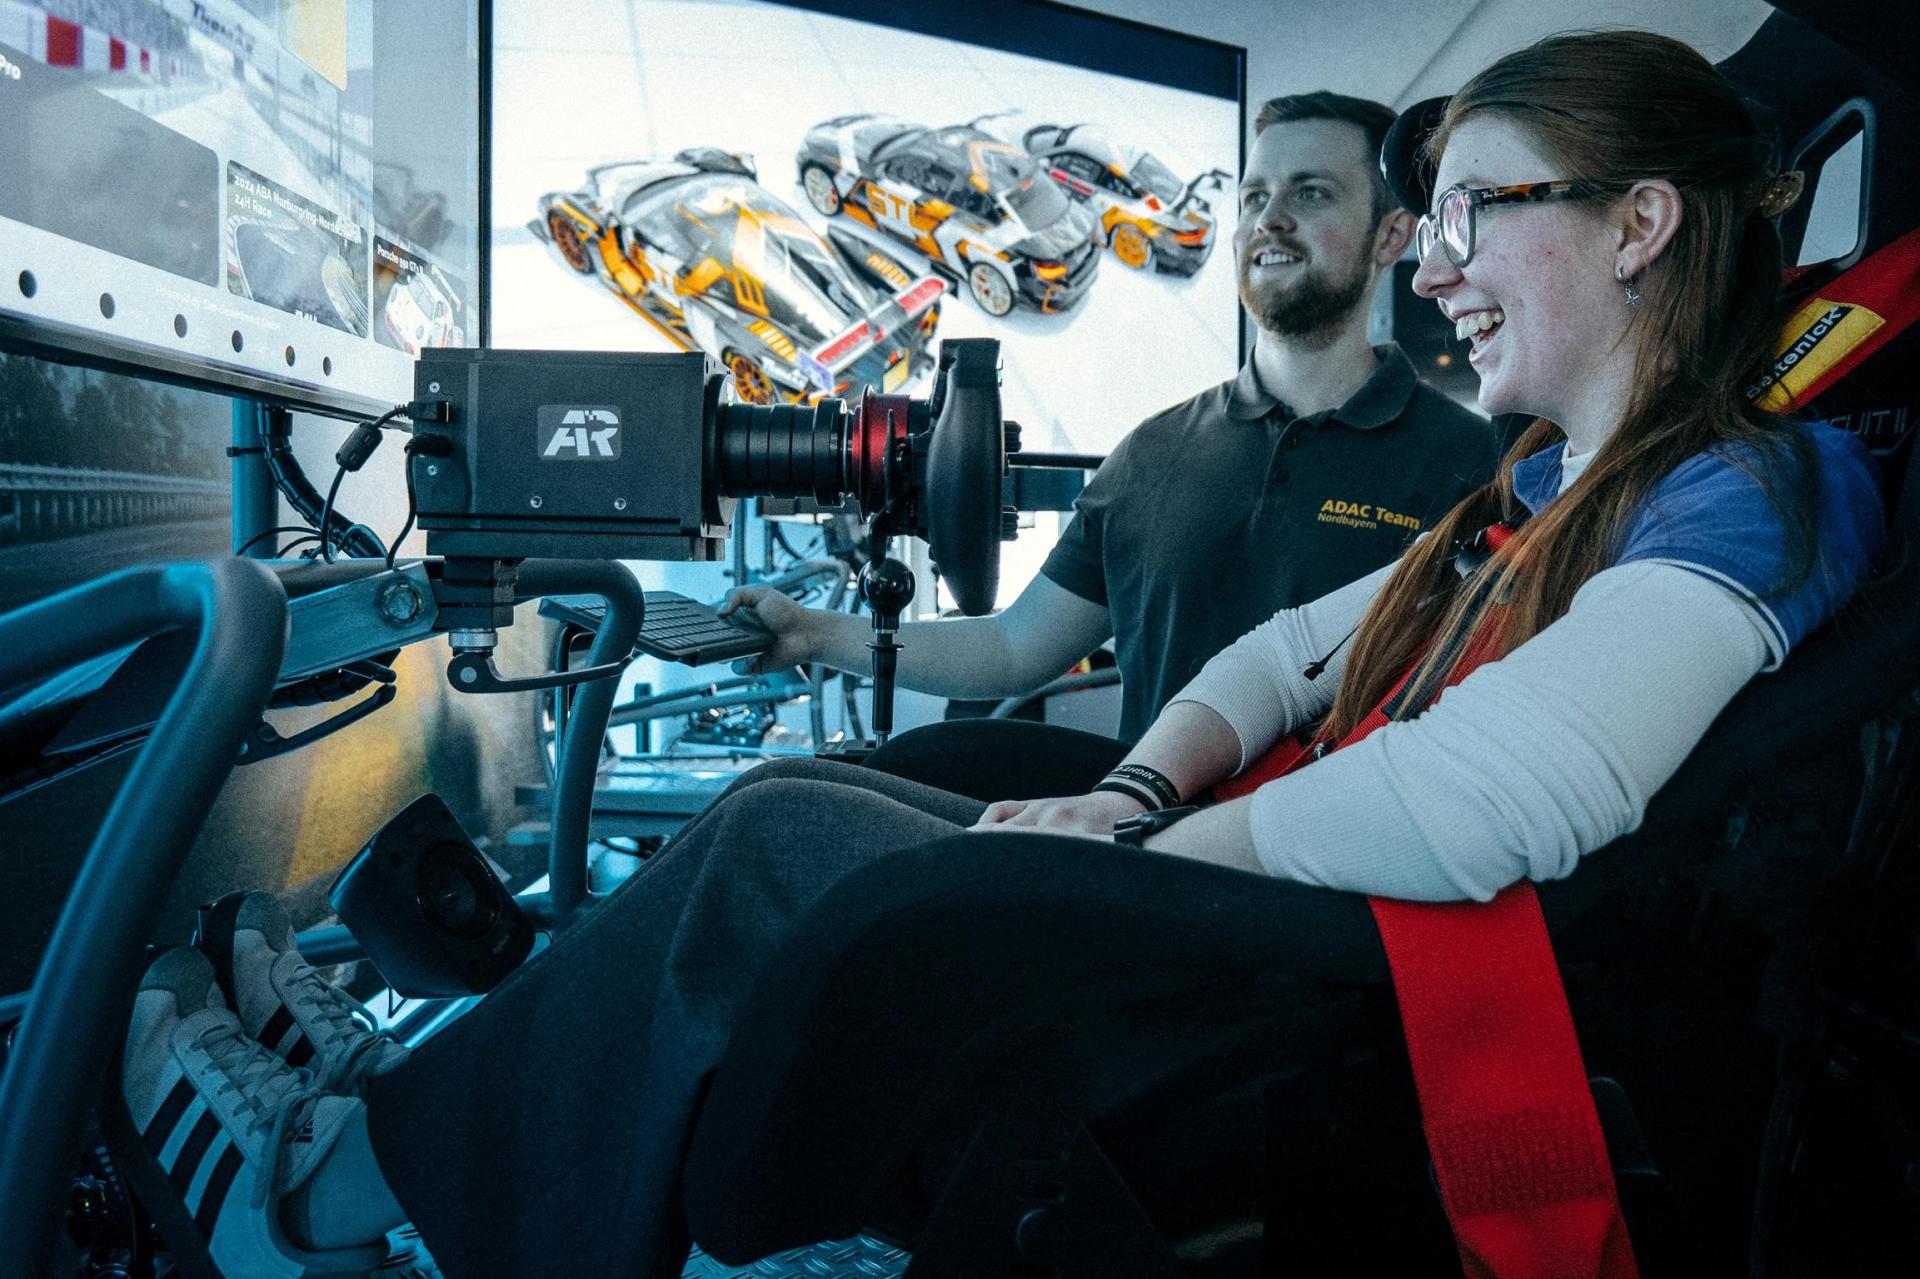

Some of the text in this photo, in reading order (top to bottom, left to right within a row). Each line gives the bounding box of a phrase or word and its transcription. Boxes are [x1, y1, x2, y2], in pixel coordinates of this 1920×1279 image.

[0, 54, 21, 80] Pro
[234, 176, 254, 194] 2024
[234, 194, 272, 219] 24H Race
[377, 243, 399, 264] Porsche
[1317, 512, 1377, 530] Nordbayern
[1321, 499, 1421, 530] ADAC Team
